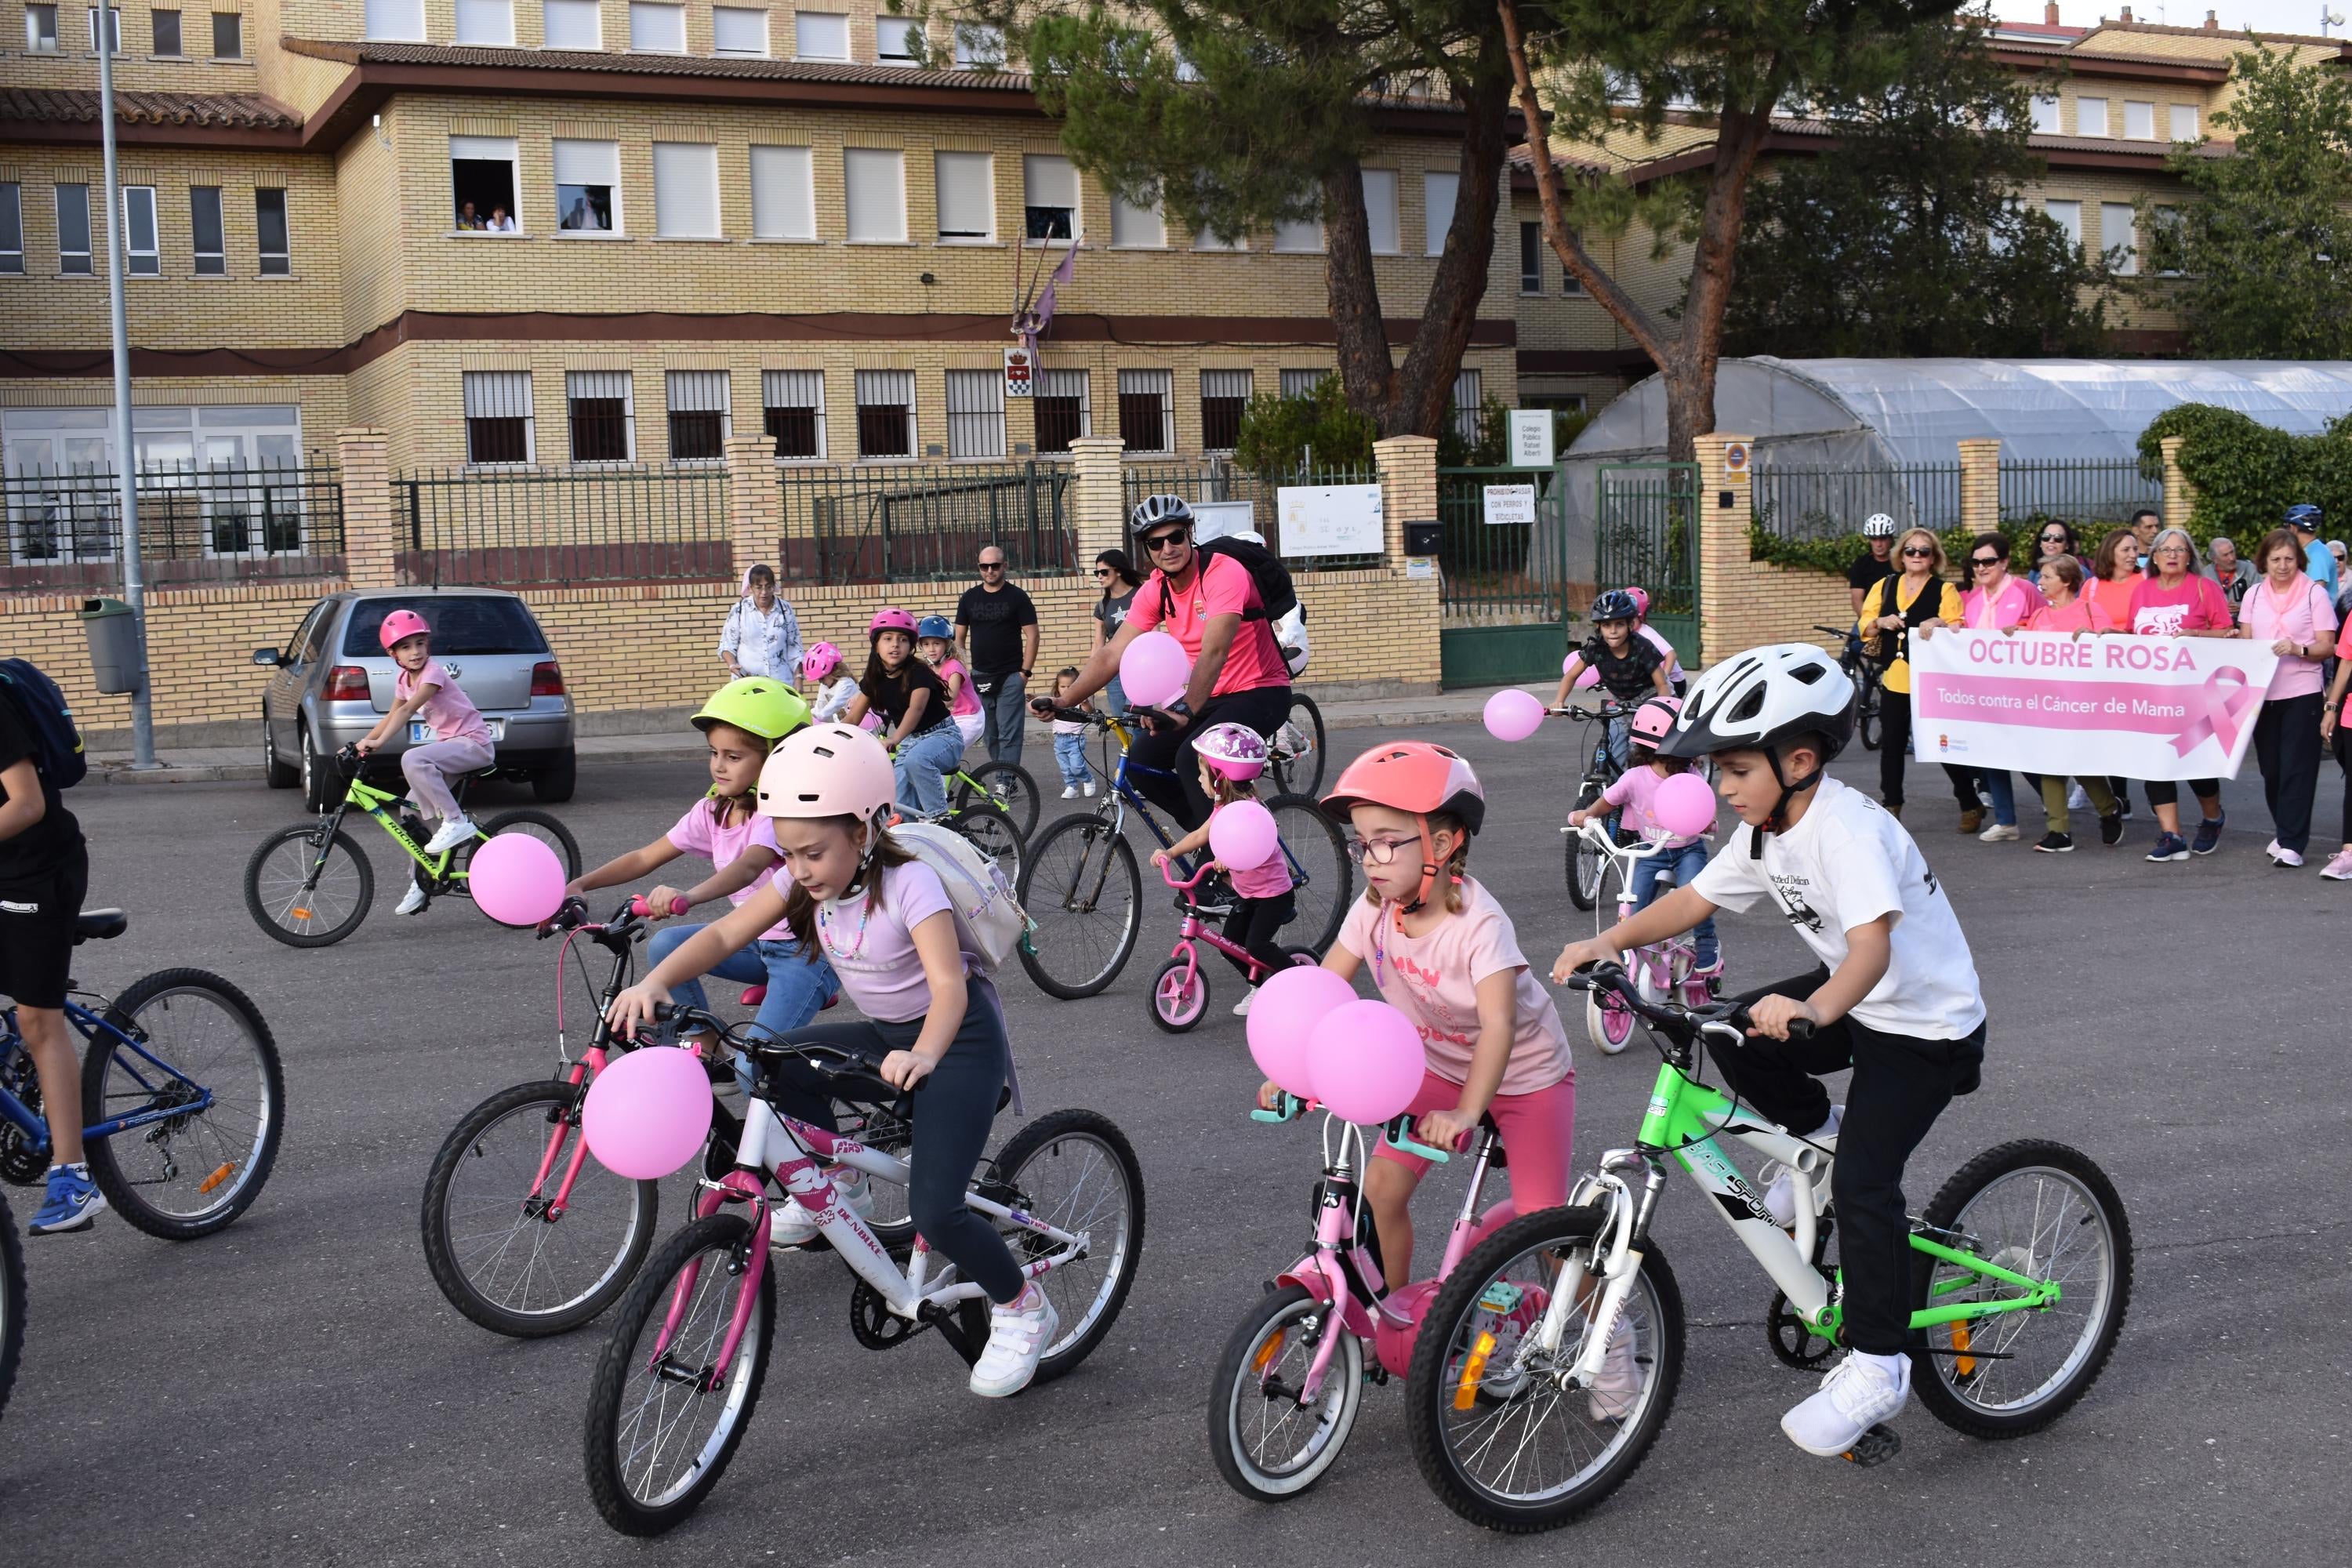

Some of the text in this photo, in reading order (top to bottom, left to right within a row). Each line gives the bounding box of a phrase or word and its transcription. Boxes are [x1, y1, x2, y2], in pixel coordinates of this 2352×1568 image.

[1969, 638, 2198, 672] OCTUBRE ROSA
[1937, 688, 2186, 717] Todos contra el Cáncer de Mama
[388, 822, 437, 869] ROCKRIDER
[837, 1207, 883, 1258] DENBIKE
